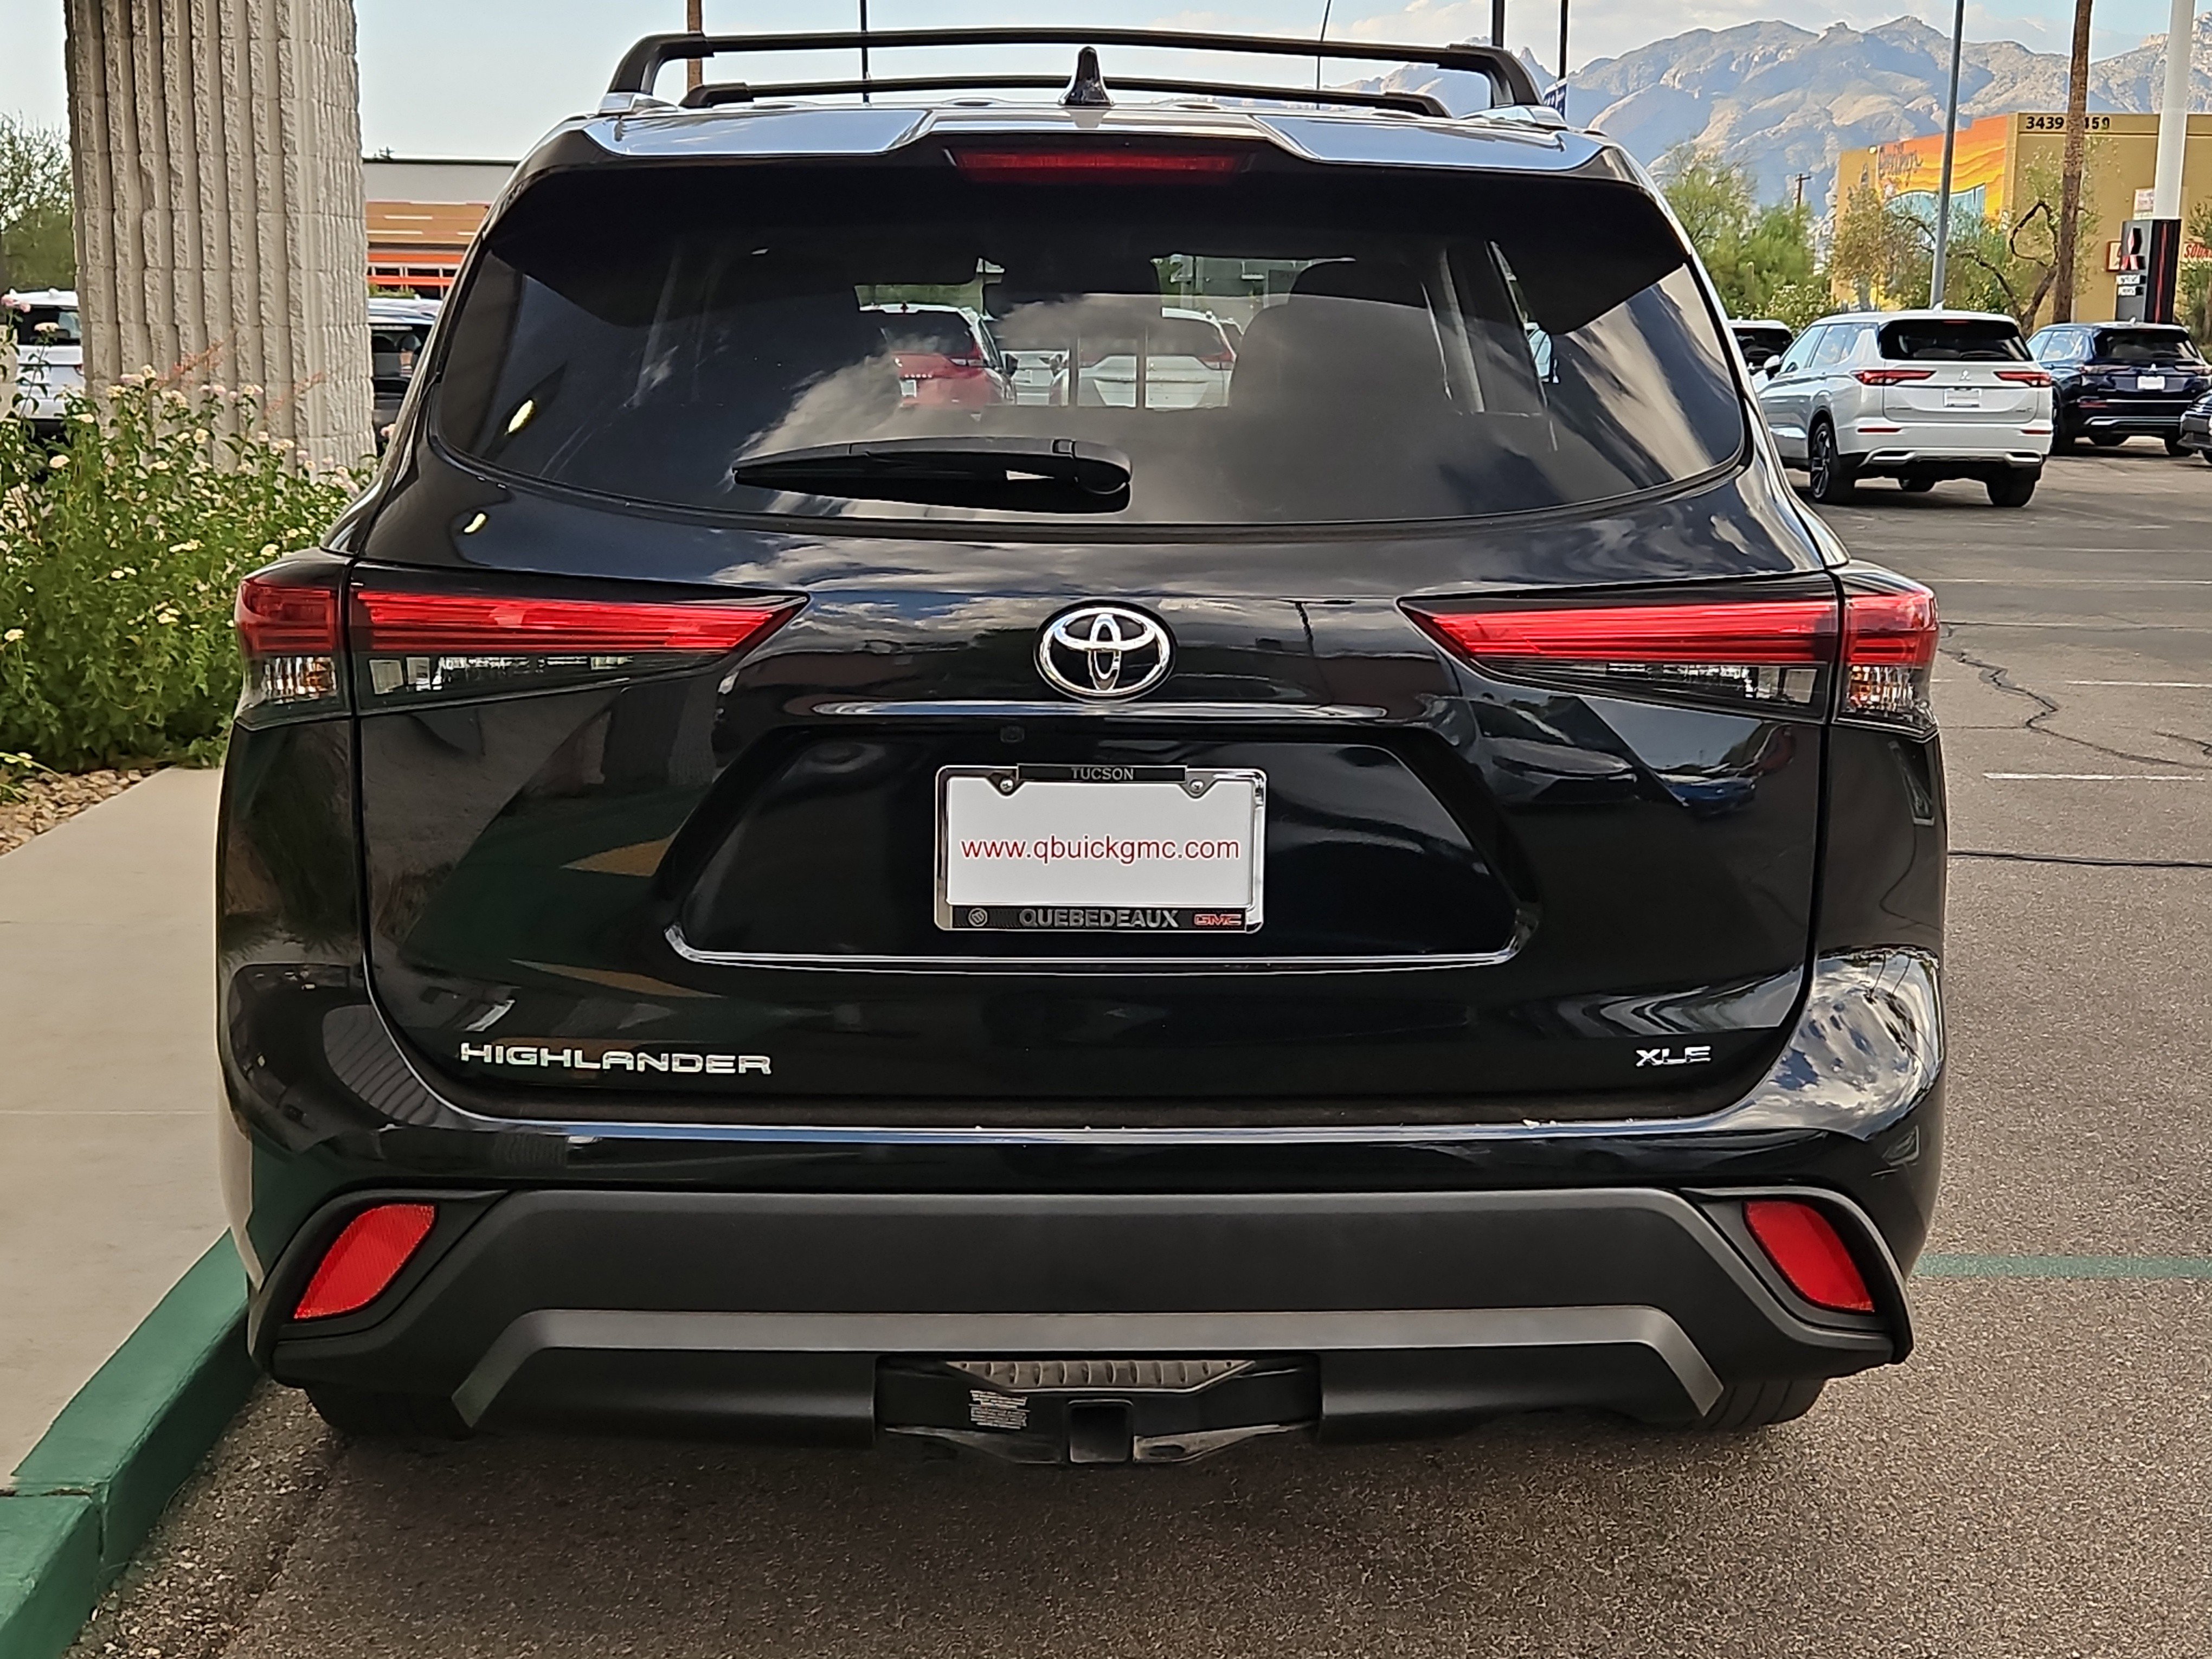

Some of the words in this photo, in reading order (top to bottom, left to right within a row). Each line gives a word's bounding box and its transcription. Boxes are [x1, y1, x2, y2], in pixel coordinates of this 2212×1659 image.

[2025, 116, 2065, 130] 3439
[1071, 767, 1134, 780] TUCSON
[961, 835, 1240, 864] www.qbuickgmc.com
[1019, 909, 1179, 928] QUEBEDEAUX
[1194, 914, 1242, 926] GMC
[460, 1042, 772, 1075] HIGHLANDER
[1636, 1045, 1712, 1067] XLE
